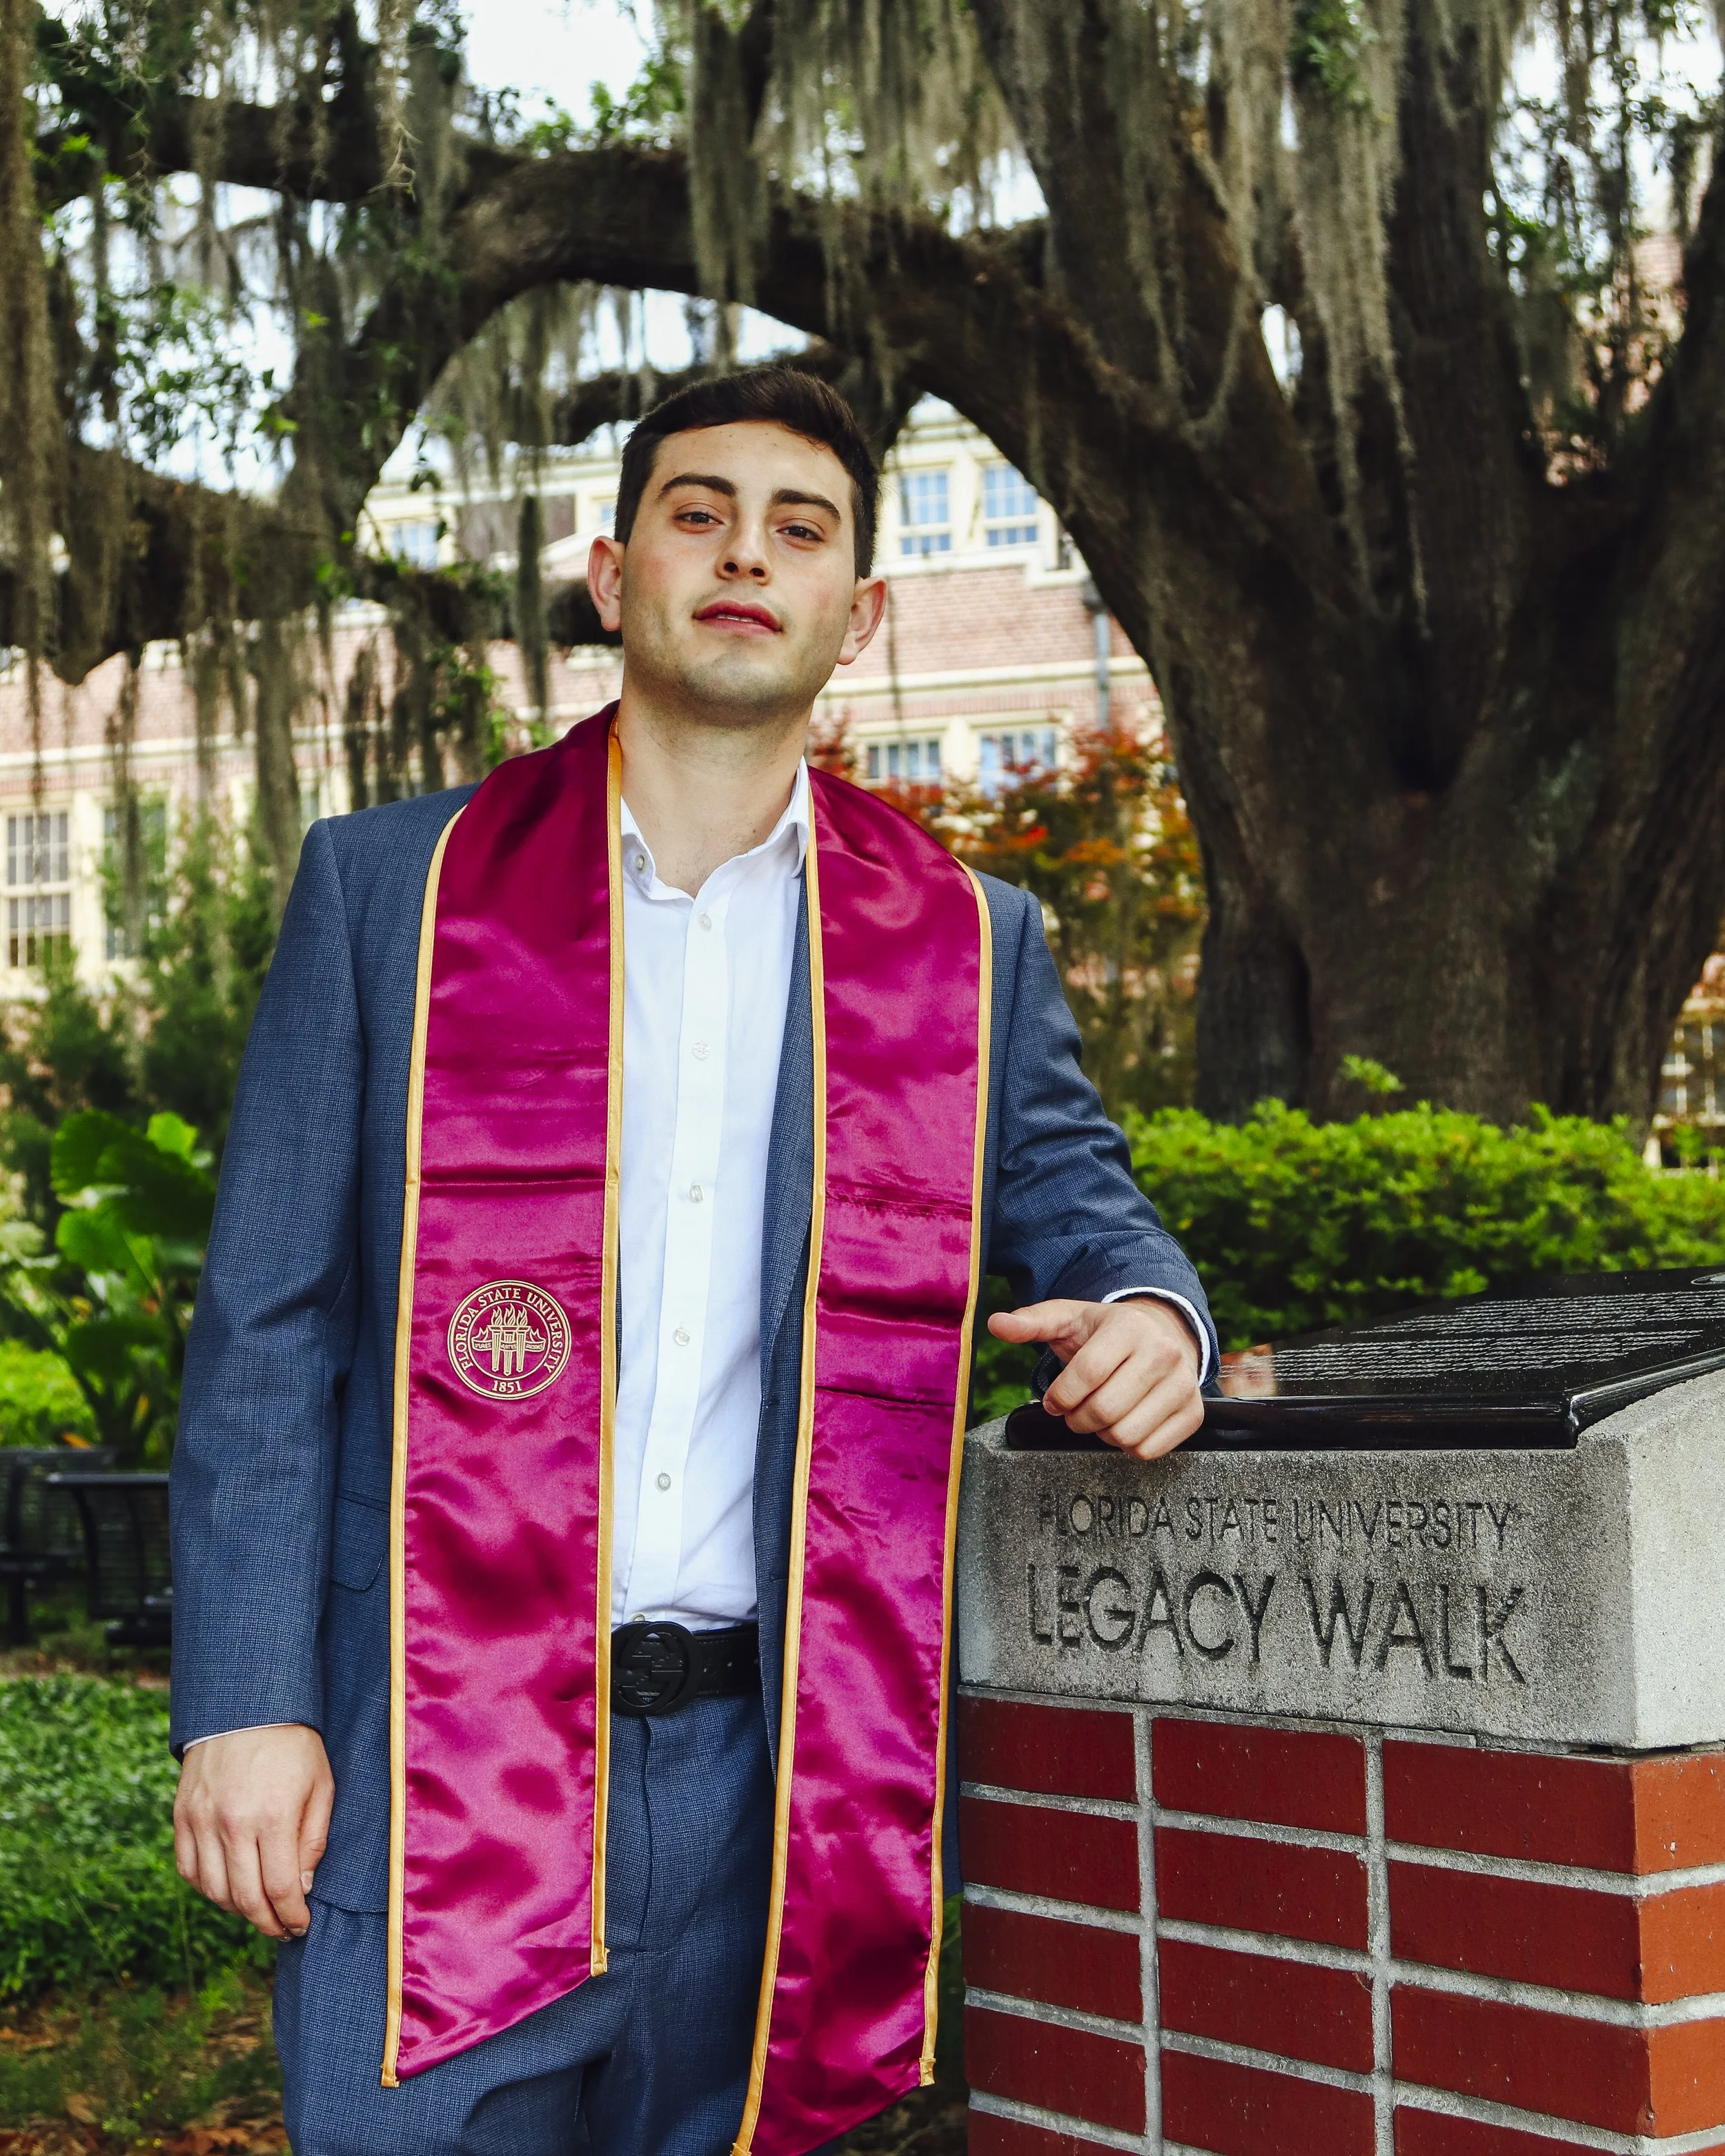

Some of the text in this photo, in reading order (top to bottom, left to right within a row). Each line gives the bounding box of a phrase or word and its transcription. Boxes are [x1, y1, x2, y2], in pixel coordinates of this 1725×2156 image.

[456, 1288, 562, 1373] FLORIDA STATE UNIVERSITY
[492, 1380, 522, 1393] 1851
[1037, 1492, 1516, 1552] FLORIDA STATE UNIVERSITY
[1027, 1562, 1526, 1684] LEGACY WALK
